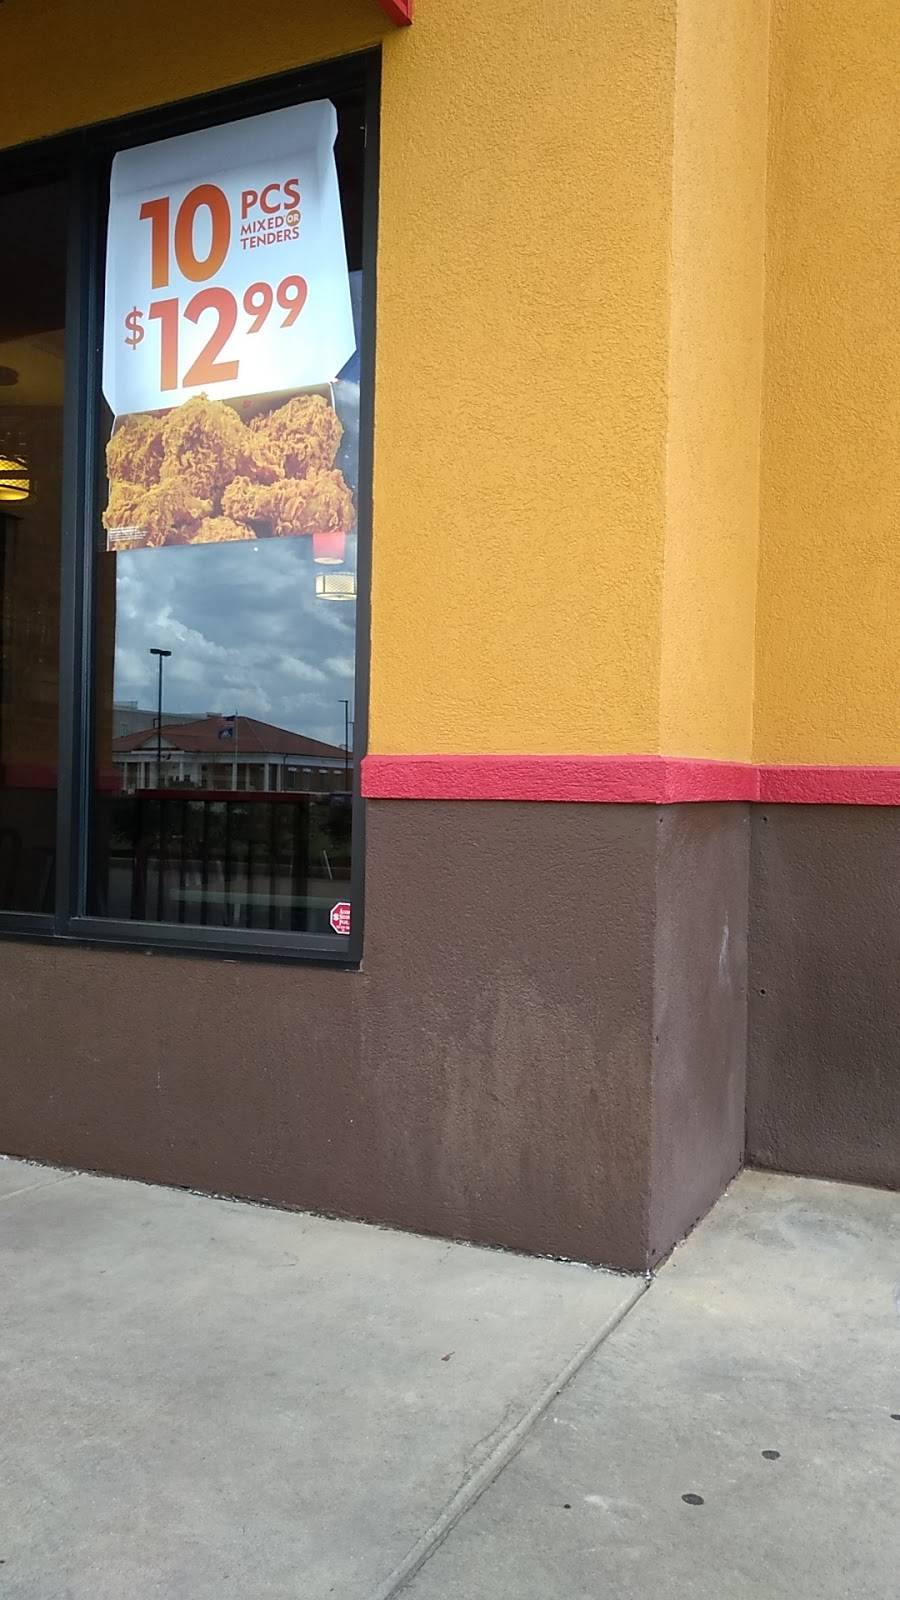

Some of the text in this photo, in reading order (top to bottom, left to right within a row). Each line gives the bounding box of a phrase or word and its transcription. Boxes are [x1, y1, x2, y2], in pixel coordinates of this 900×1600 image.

[241, 179, 301, 219] PCS
[139, 183, 231, 290] 10
[240, 211, 300, 236] MIXED OR
[240, 227, 300, 250] TENDERS
